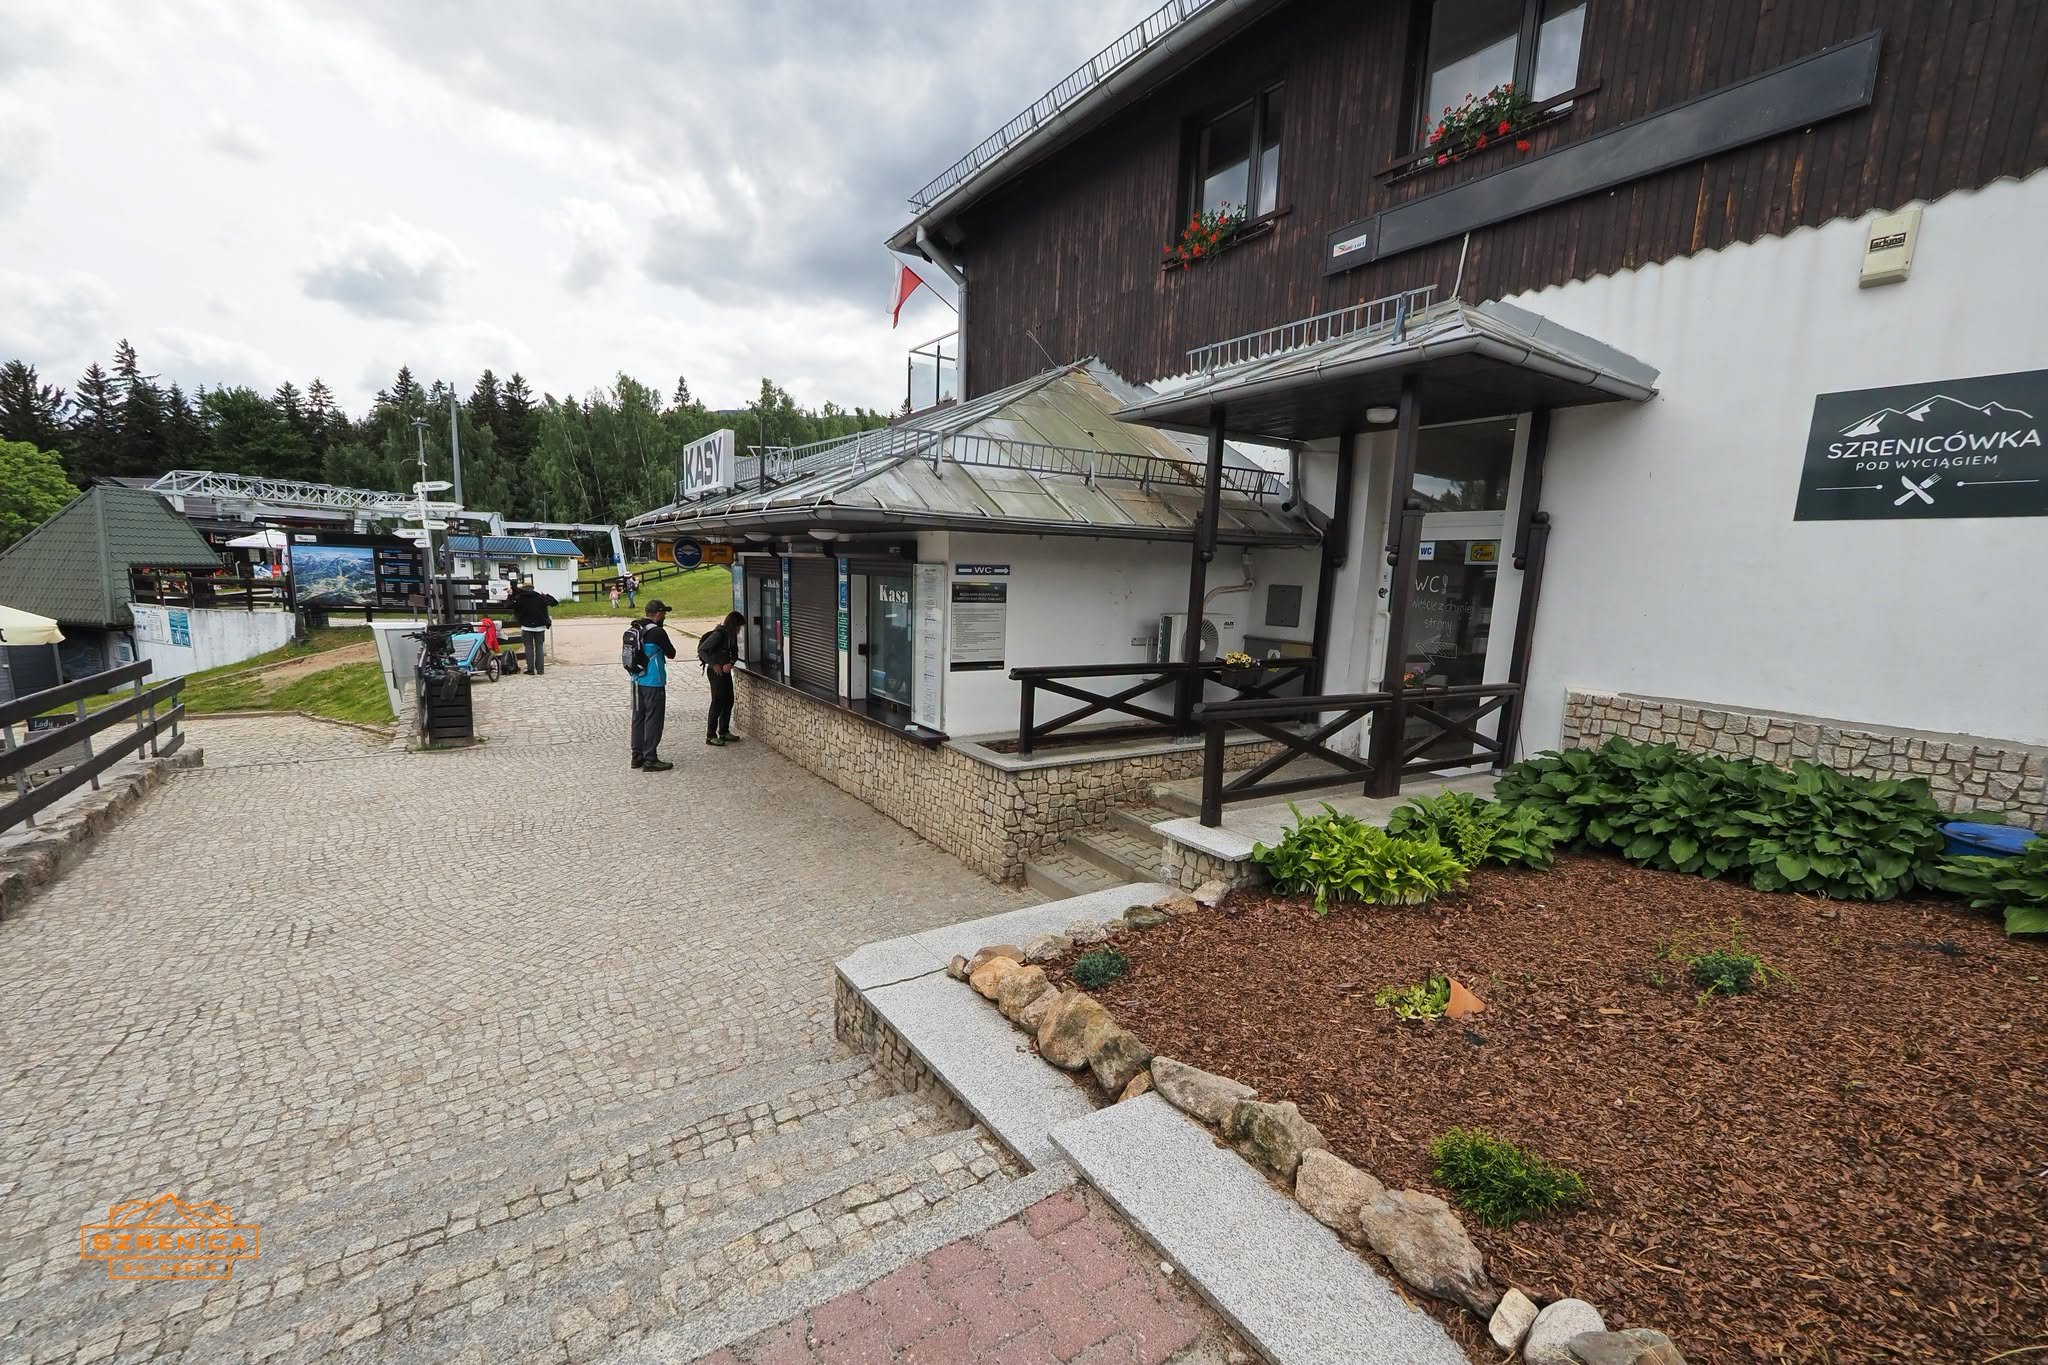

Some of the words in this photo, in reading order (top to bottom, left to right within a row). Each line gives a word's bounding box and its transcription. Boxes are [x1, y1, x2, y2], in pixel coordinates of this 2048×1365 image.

[1827, 429, 2042, 460] SZRENICÓWKA
[685, 436, 722, 490] KASY
[1855, 461, 1890, 472] POD
[1895, 454, 1999, 470] WYCIĄGIEM
[1420, 546, 1433, 556] WC
[974, 566, 992, 574] WC
[879, 584, 909, 604] Kasa
